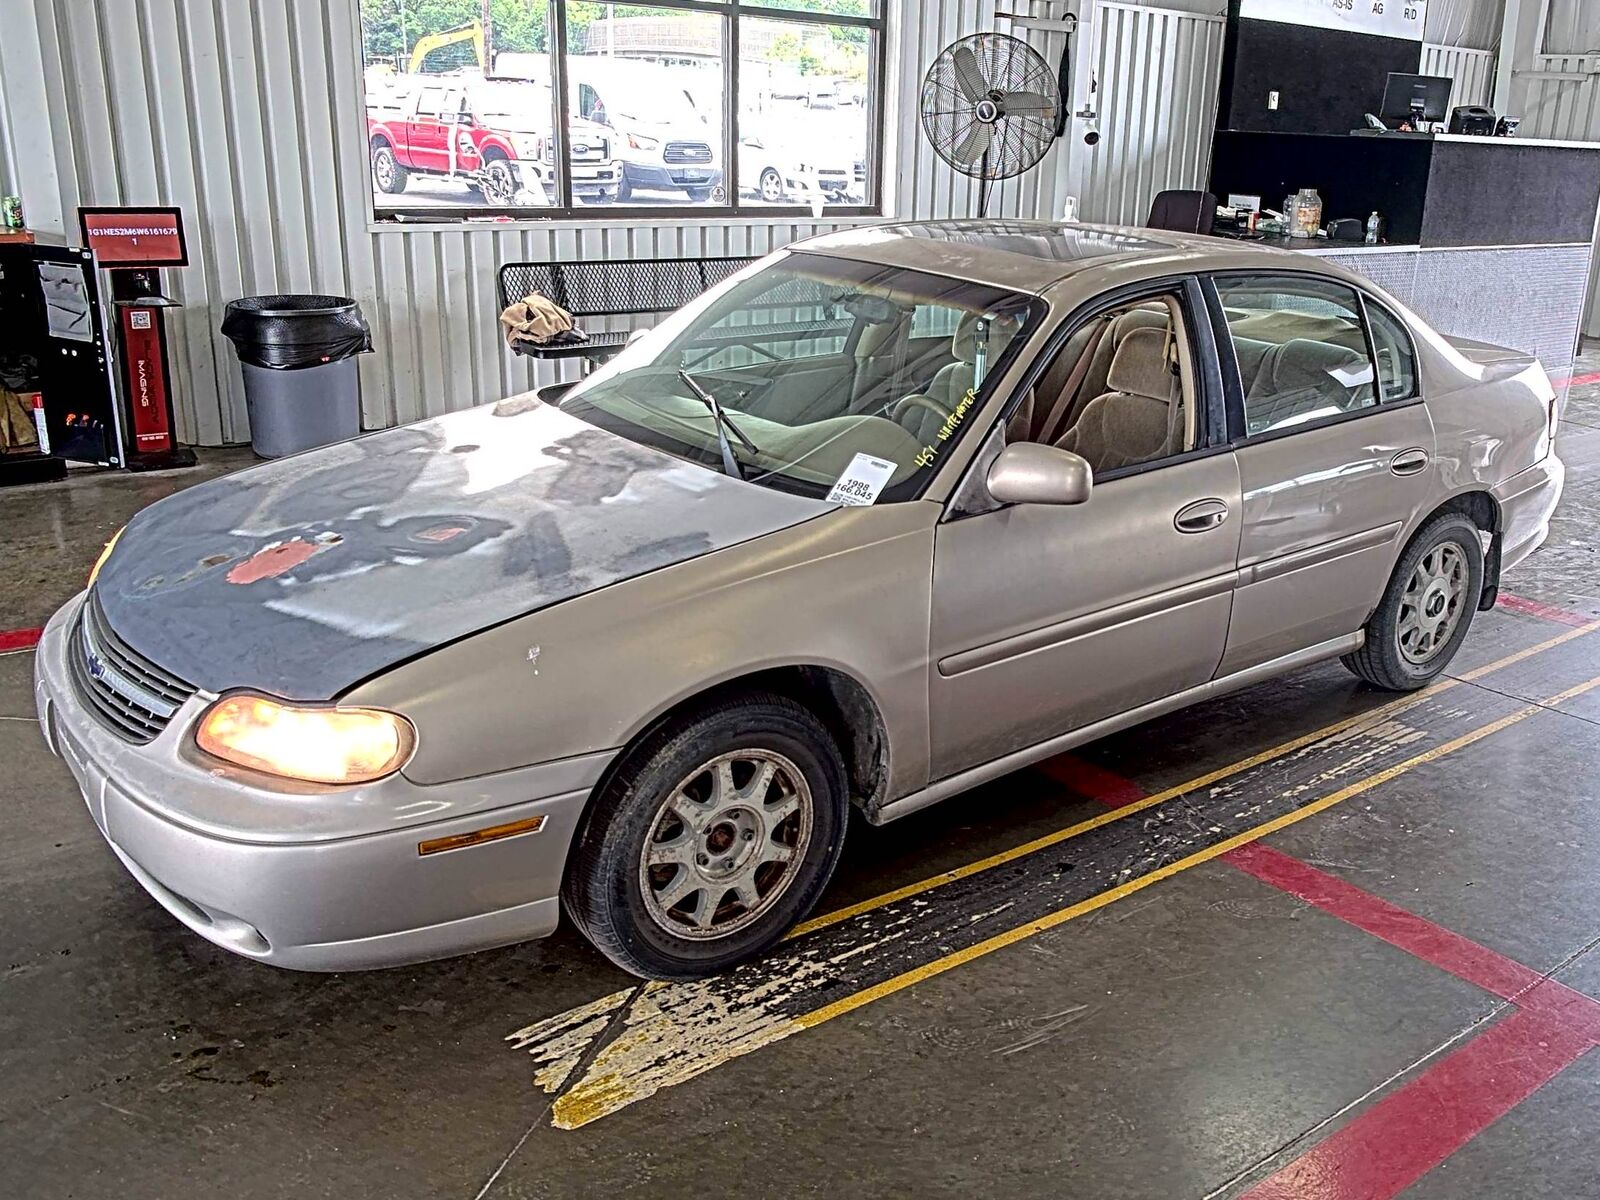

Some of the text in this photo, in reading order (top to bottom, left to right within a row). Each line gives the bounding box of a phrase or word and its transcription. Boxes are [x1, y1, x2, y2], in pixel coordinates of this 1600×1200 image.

[1372, 3, 1384, 14] AG
[138, 360, 149, 407] IMAGING
[836, 483, 873, 500] 166,045
[847, 479, 870, 492] 1998
